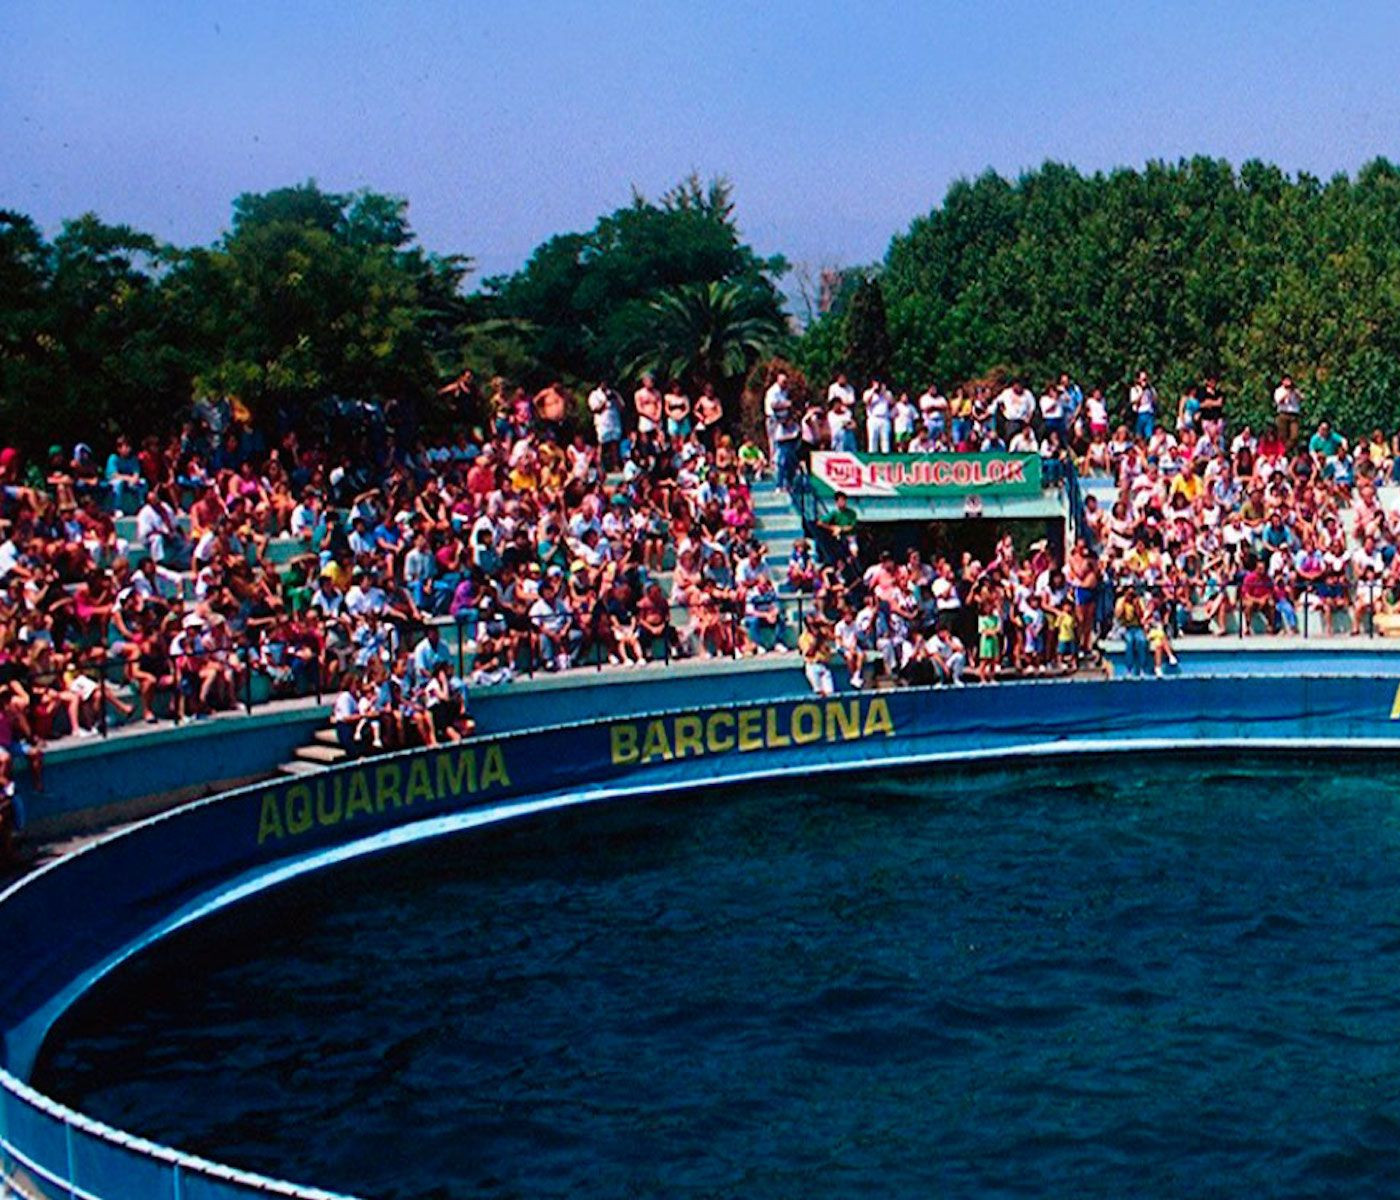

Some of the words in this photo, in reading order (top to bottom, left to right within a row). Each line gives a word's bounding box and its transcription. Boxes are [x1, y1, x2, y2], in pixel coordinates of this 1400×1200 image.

[868, 460, 1026, 484] FUJICOLOR
[610, 697, 896, 764] BARCELONA
[257, 744, 511, 844] AQUARAMA
